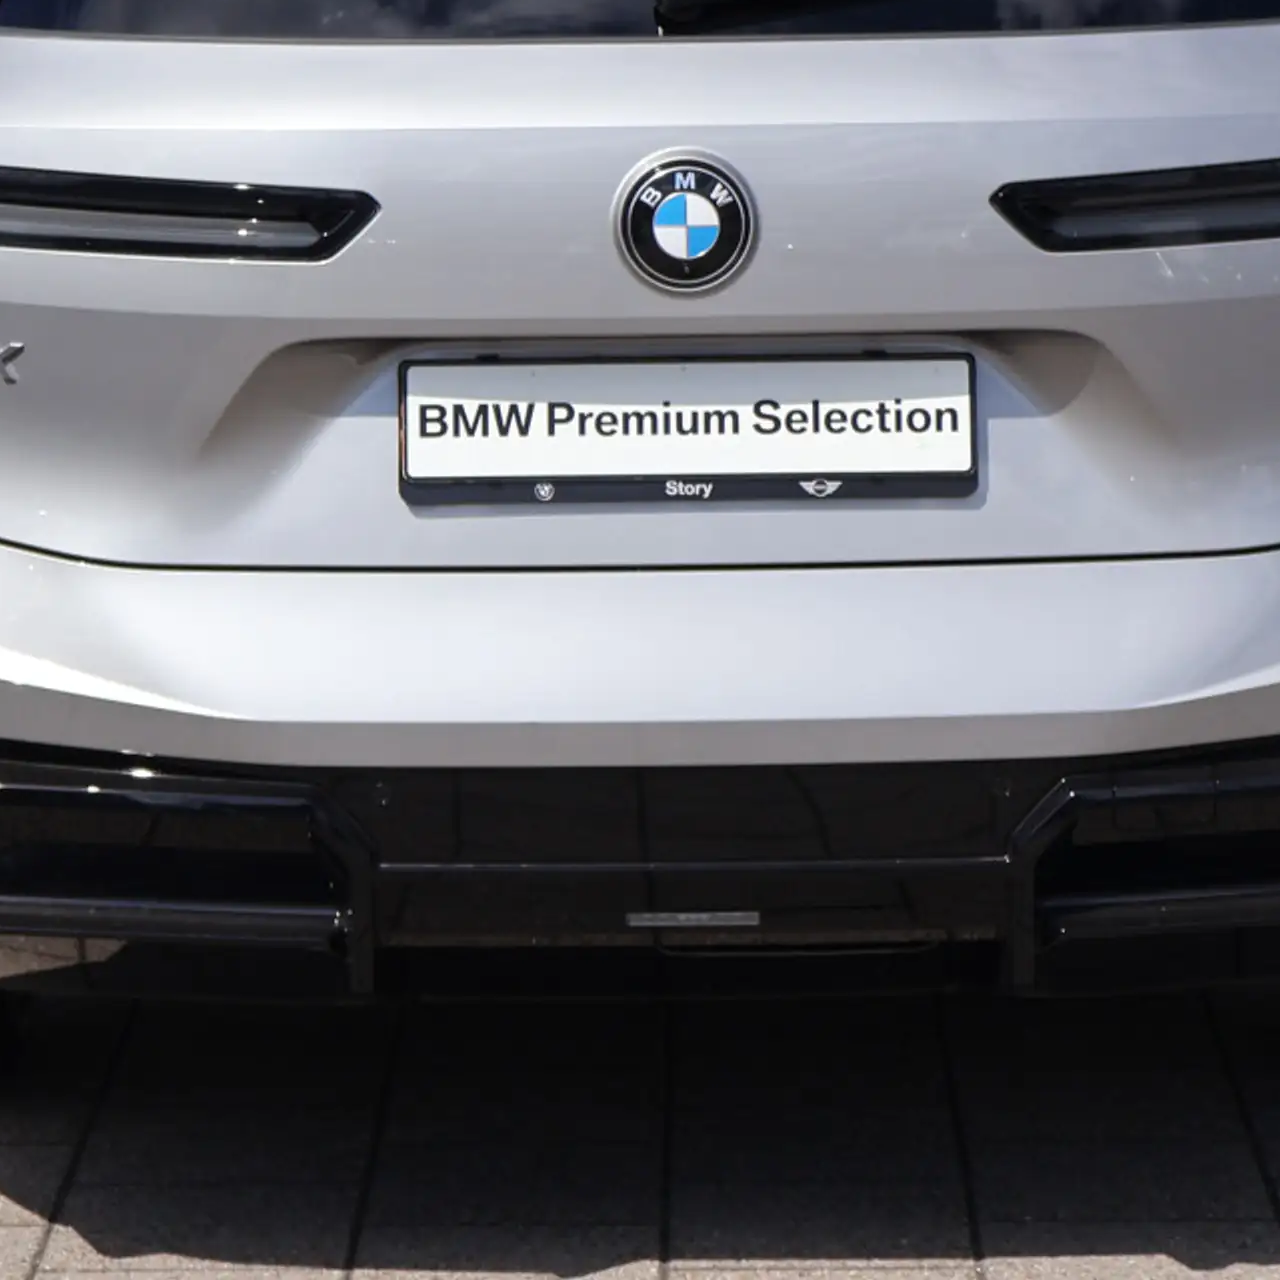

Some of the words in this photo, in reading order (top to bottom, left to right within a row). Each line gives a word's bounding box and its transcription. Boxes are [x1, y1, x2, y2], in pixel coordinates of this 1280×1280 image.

[641, 172, 733, 208] BMW
[419, 403, 534, 438] BMW
[548, 400, 740, 437] Premium
[753, 400, 959, 436] Selection
[666, 481, 712, 498] Story
